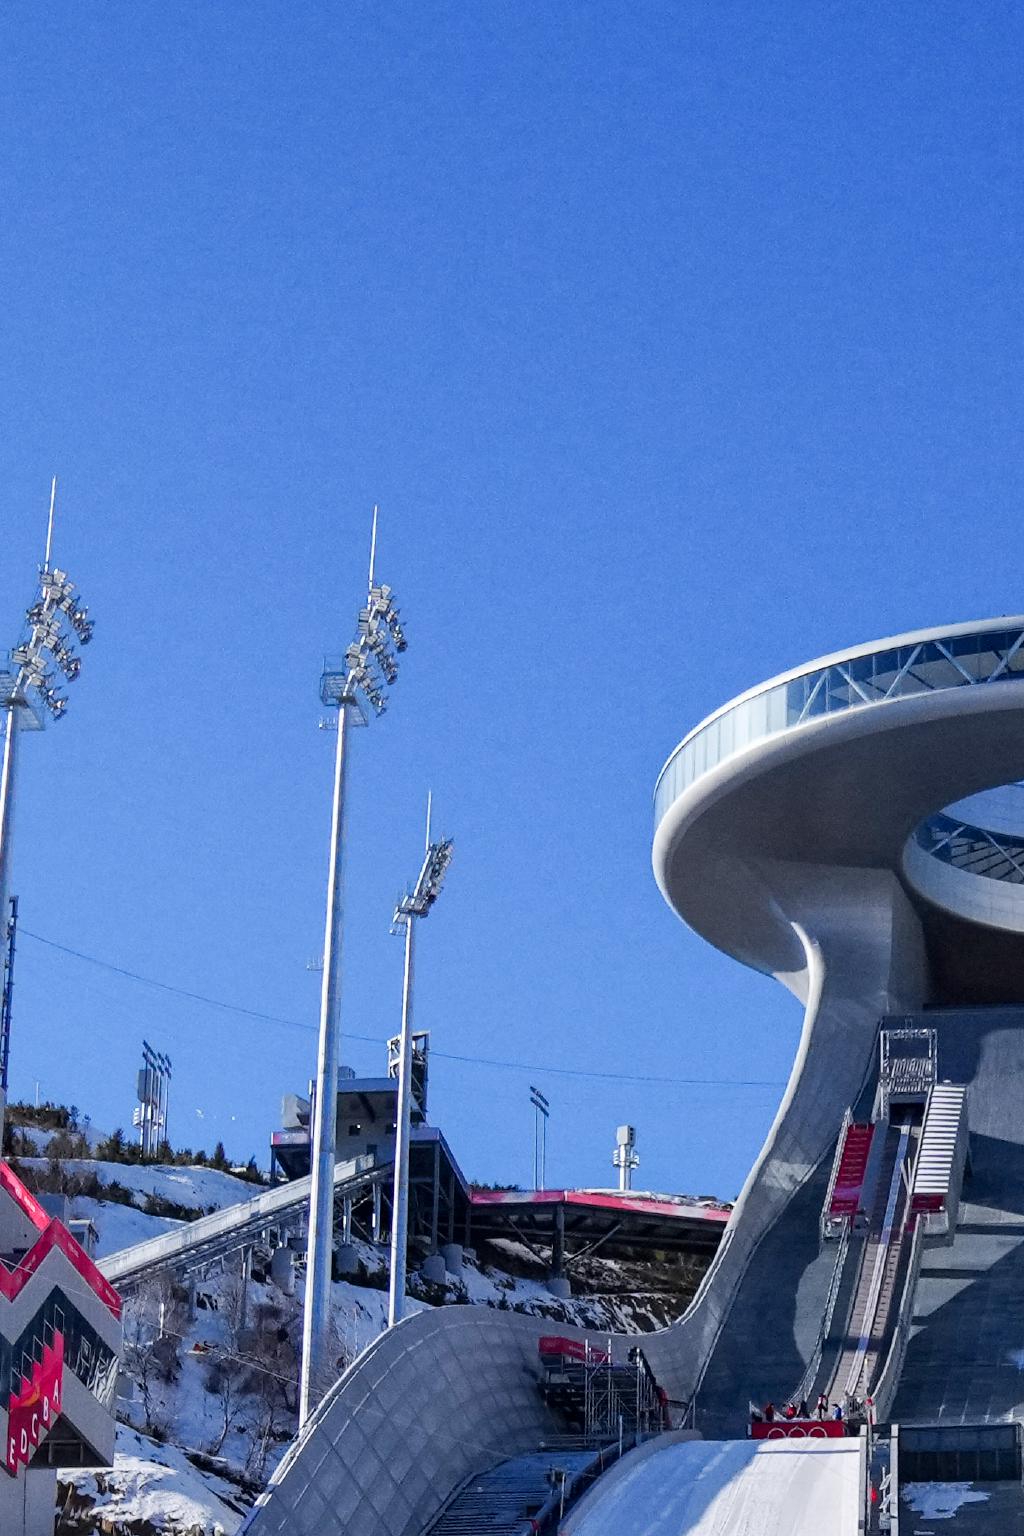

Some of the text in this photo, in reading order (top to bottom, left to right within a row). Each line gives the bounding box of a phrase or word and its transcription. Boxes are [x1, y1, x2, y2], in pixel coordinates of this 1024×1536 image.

[53, 1379, 59, 1404] A
[43, 1396, 49, 1421] B
[32, 1413, 38, 1438] C
[10, 1437, 16, 1465] E
[21, 1428, 28, 1454] D
